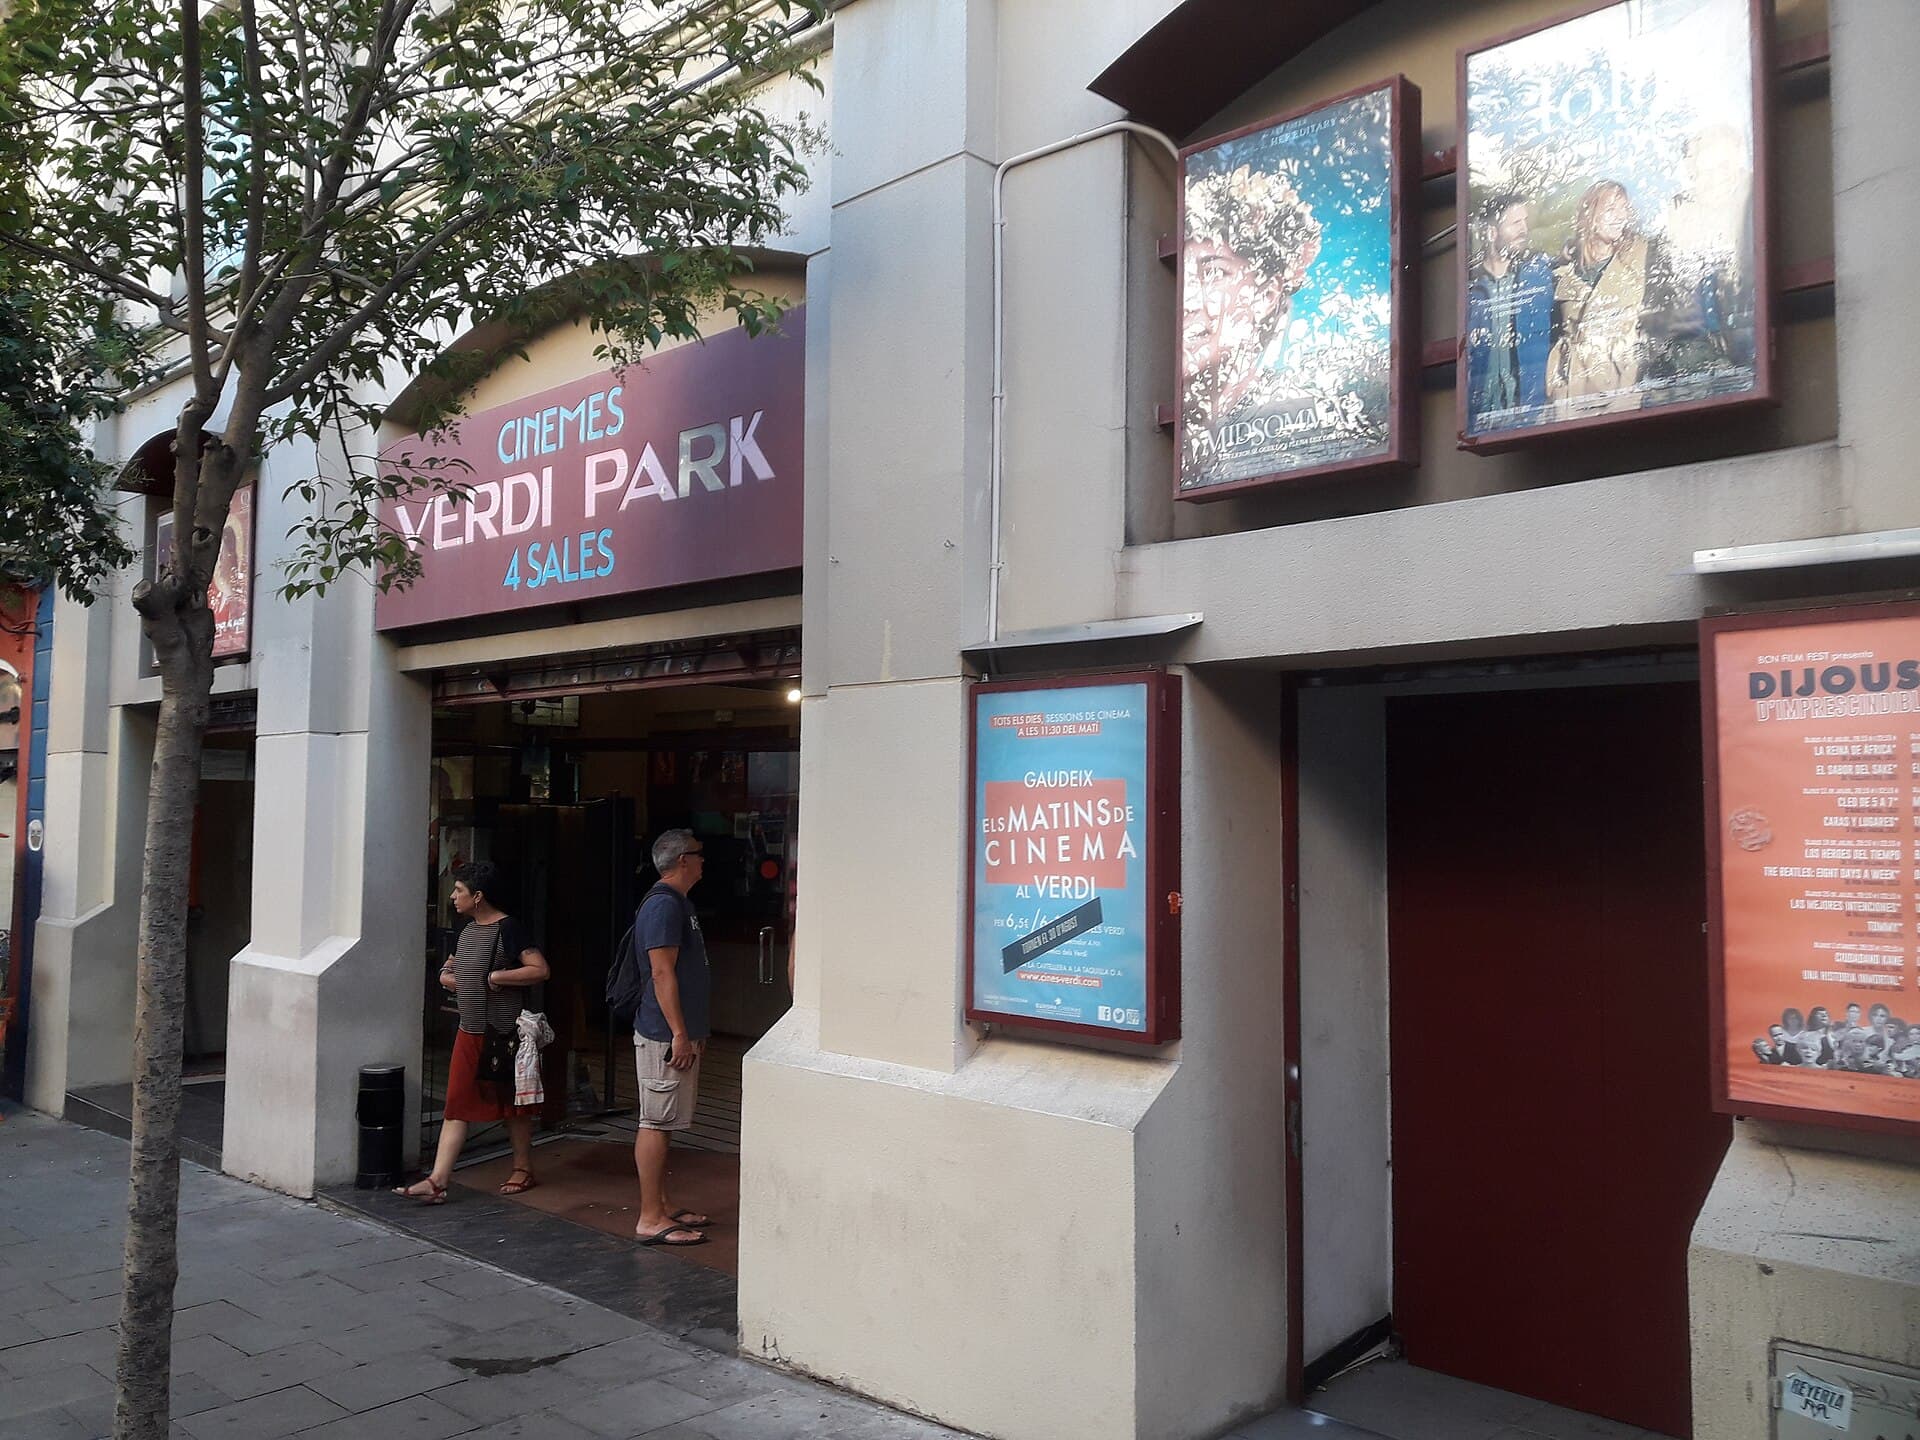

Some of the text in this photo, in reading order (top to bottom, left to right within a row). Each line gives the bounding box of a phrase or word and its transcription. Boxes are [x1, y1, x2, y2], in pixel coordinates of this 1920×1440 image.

[497, 386, 625, 464] CINEMES
[395, 409, 776, 551] VERDI PARK
[503, 527, 615, 591] 4 SALES
[1781, 654, 1804, 663] FILM
[1807, 652, 1830, 662] FEST
[1749, 660, 1920, 699] DIJOUS
[994, 717, 1011, 726] TOTS
[1012, 716, 1024, 725] ELS
[1046, 713, 1083, 723] SESSIONS
[1085, 711, 1096, 721] DE
[1097, 710, 1130, 720] CINEMA
[1018, 727, 1025, 737] A
[1026, 726, 1039, 736] LES
[1041, 725, 1061, 735] 11:30
[1062, 724, 1077, 734] DEL
[1024, 770, 1093, 788] GAUDEIX
[983, 798, 1135, 833] ELS MATINS DE
[985, 831, 1137, 866] CINEMA
[1015, 875, 1095, 899] AL VERDI
